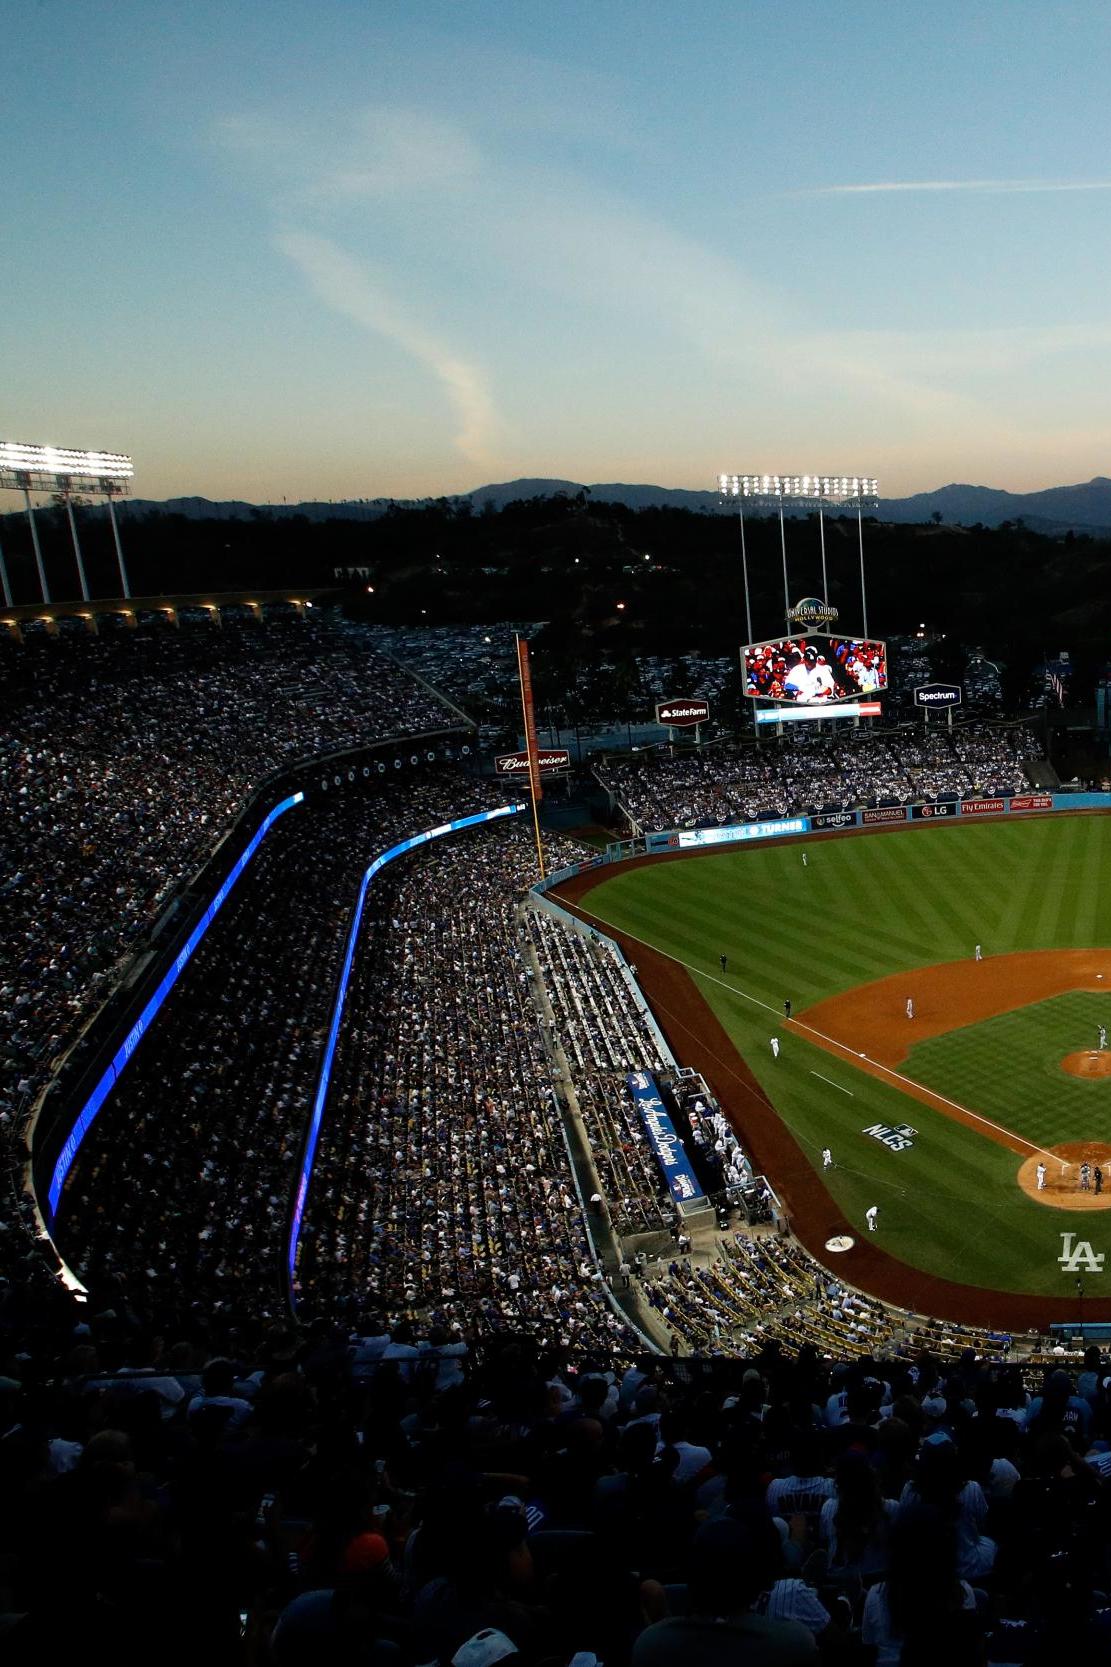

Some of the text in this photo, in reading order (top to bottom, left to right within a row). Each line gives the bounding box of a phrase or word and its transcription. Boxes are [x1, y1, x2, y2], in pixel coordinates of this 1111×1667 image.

[919, 692, 955, 701] Spectrum
[934, 806, 947, 815] LG
[962, 804, 973, 814] Fly
[975, 801, 1004, 811] Emirates
[862, 1124, 913, 1151] NLCS
[1058, 1233, 1104, 1271] LA
